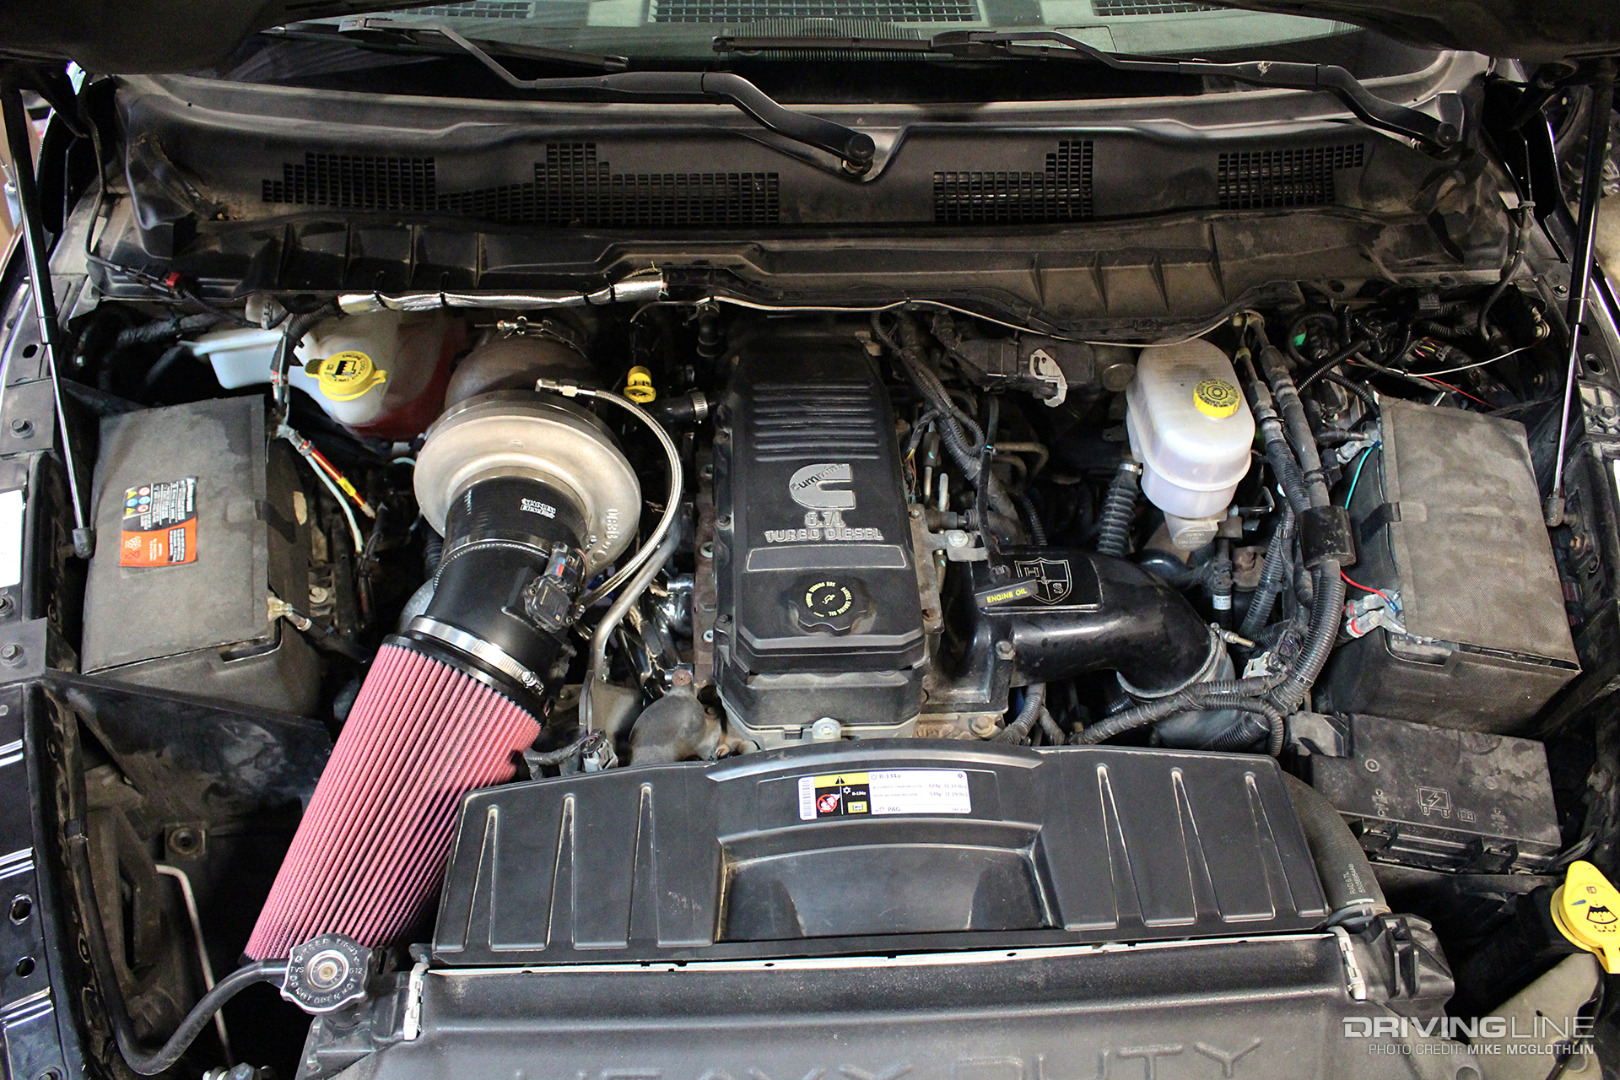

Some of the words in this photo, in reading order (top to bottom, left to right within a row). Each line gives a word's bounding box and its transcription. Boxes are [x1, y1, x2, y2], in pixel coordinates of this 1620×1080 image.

[804, 511, 846, 528] 6.7L
[764, 528, 822, 543] TURBO
[823, 527, 884, 541] DIESEL
[986, 592, 1014, 603] ENGINE
[1015, 588, 1028, 596] OIL
[1052, 582, 1064, 594] S
[290, 966, 305, 974] TVS
